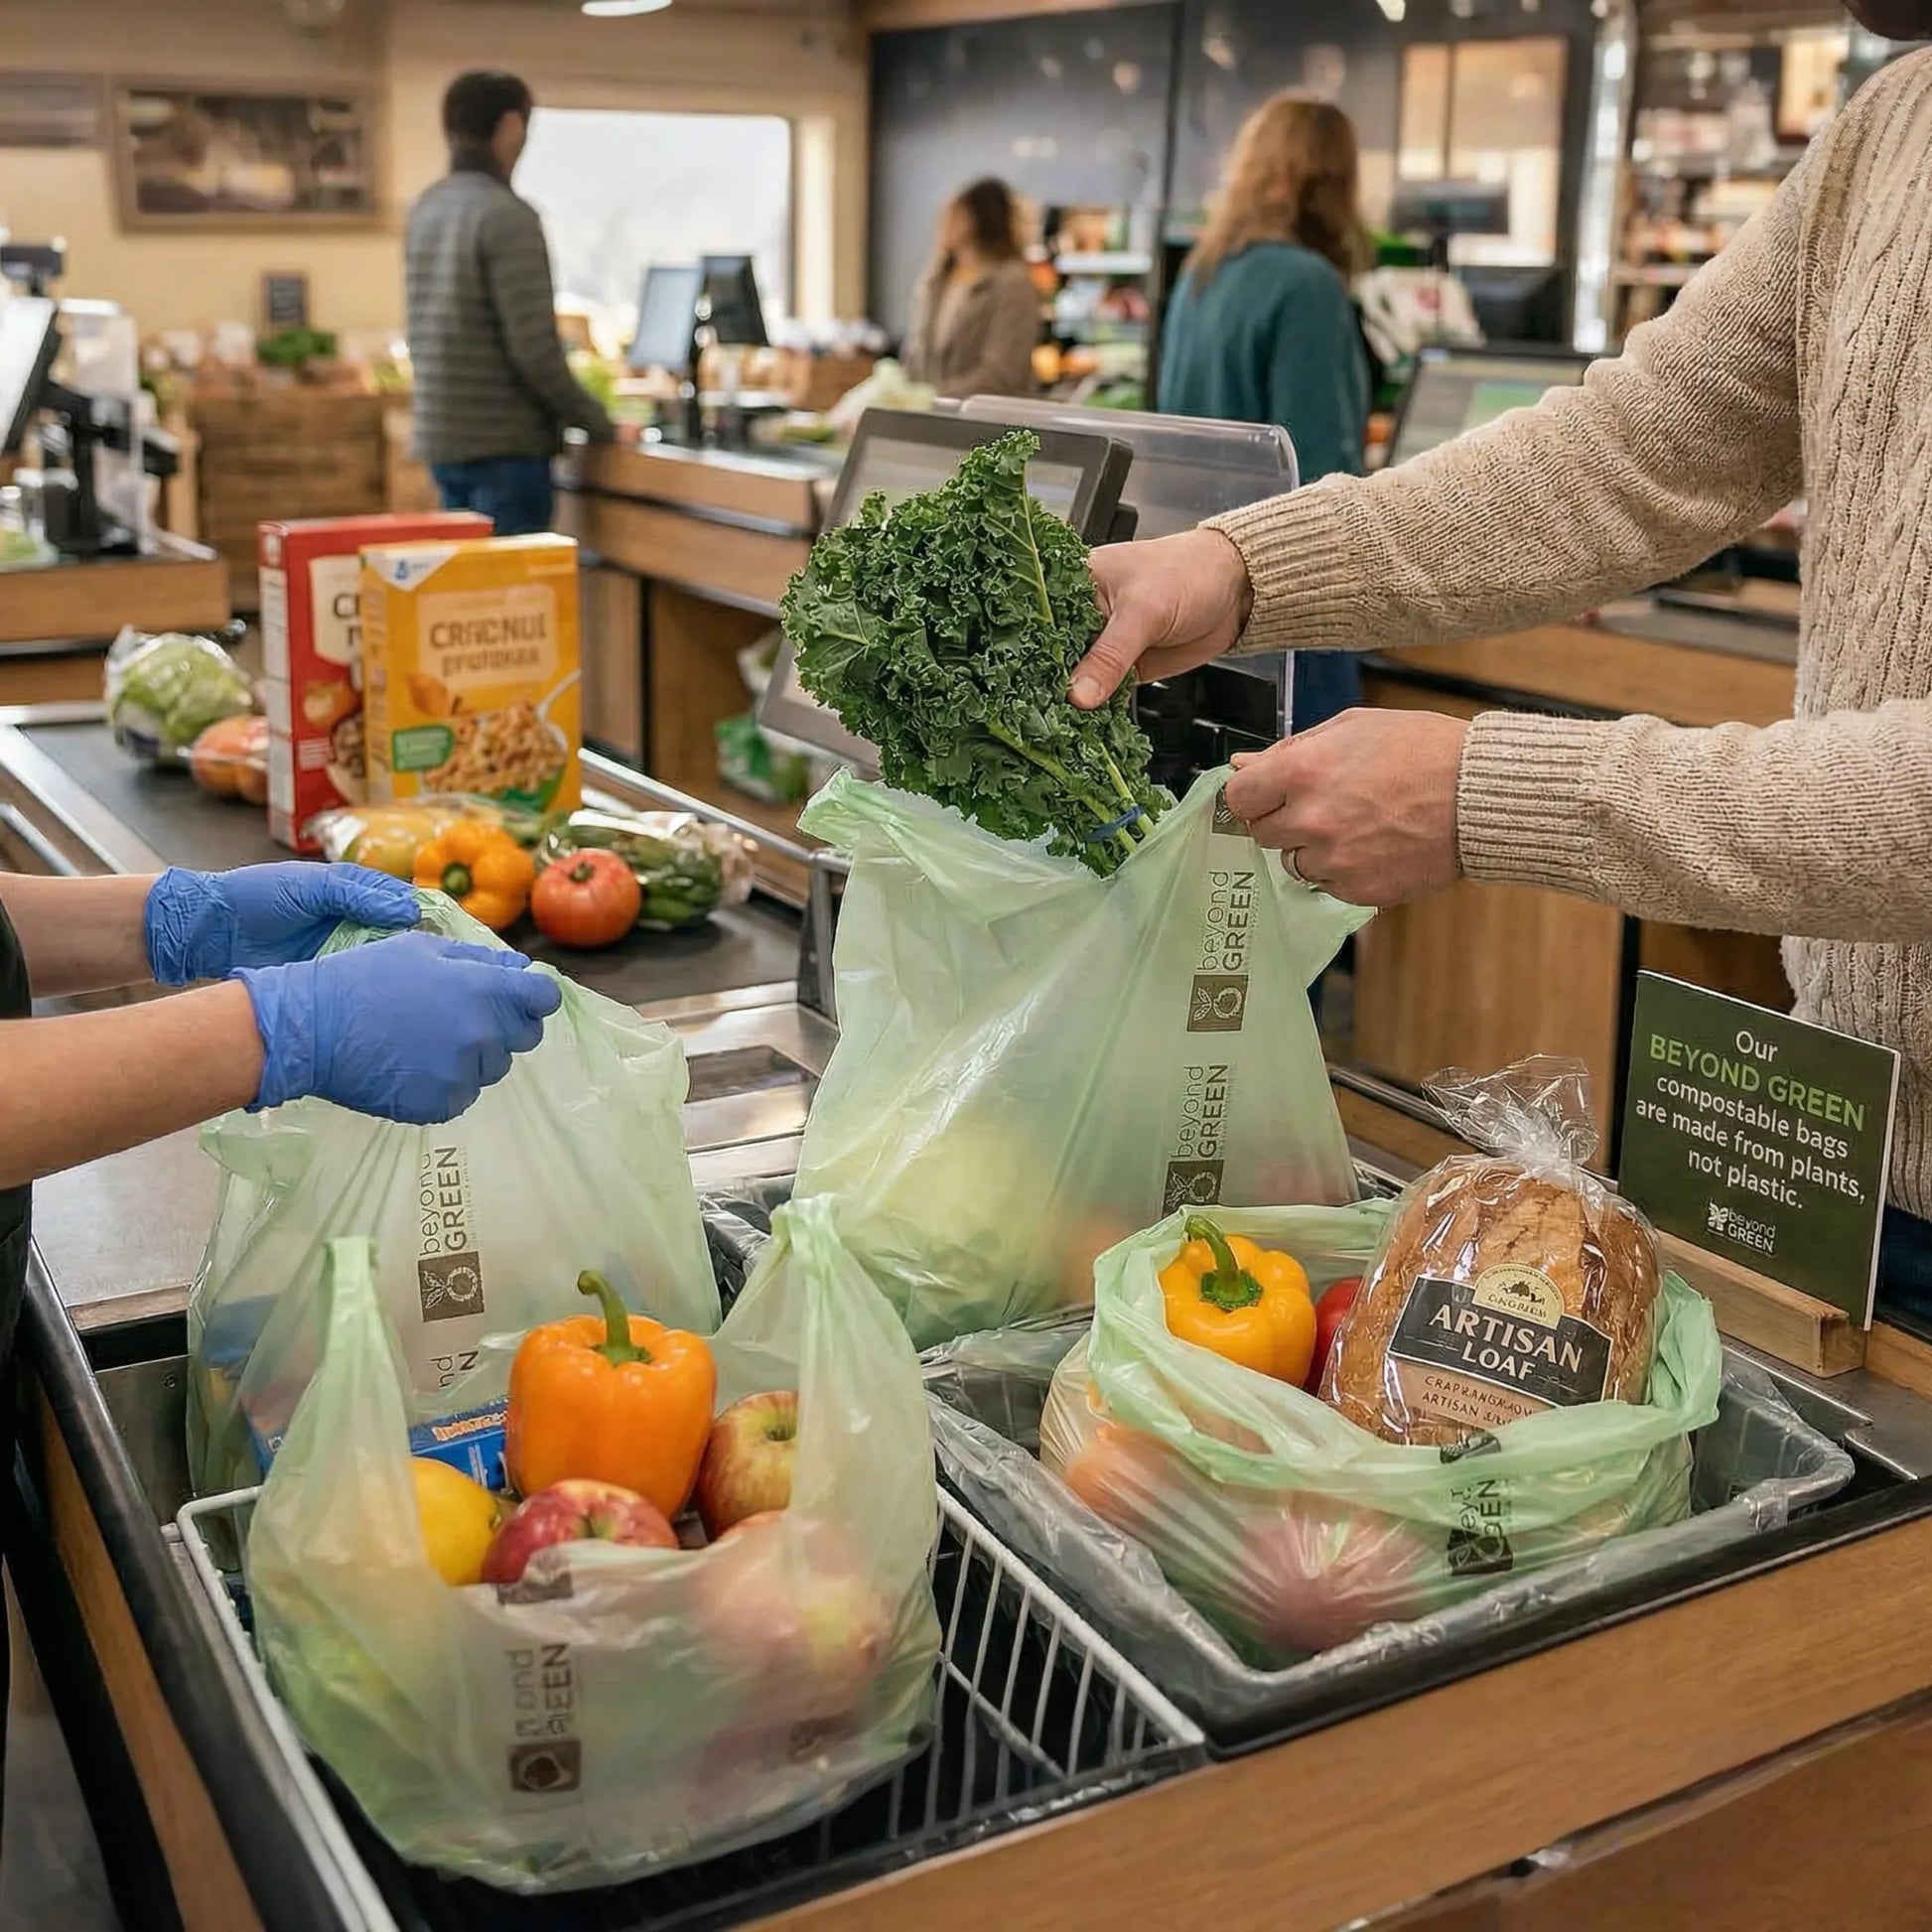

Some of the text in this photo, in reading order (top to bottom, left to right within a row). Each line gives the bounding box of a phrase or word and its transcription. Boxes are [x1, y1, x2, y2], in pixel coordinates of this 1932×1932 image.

[1196, 871, 1229, 971] beyond
[1222, 871, 1256, 971] GREEN
[1650, 1035, 1864, 1132] BEYOND GREEN
[1736, 1031, 1778, 1062] Our
[1171, 1065, 1204, 1158] beyond
[1197, 1064, 1229, 1159] GREEN
[1636, 1099, 1865, 1205] are made from plants,
[1657, 1076, 1849, 1160] compostable bags
[434, 1147, 468, 1251] GREEN
[1689, 1149, 1803, 1209] not plastic.
[1728, 1207, 1776, 1239] beyond
[1728, 1223, 1774, 1253] GREEN
[1429, 1304, 1584, 1373] ARTISAN
[1461, 1341, 1536, 1380] LOAF
[1422, 1392, 1479, 1417] ARTISAN
